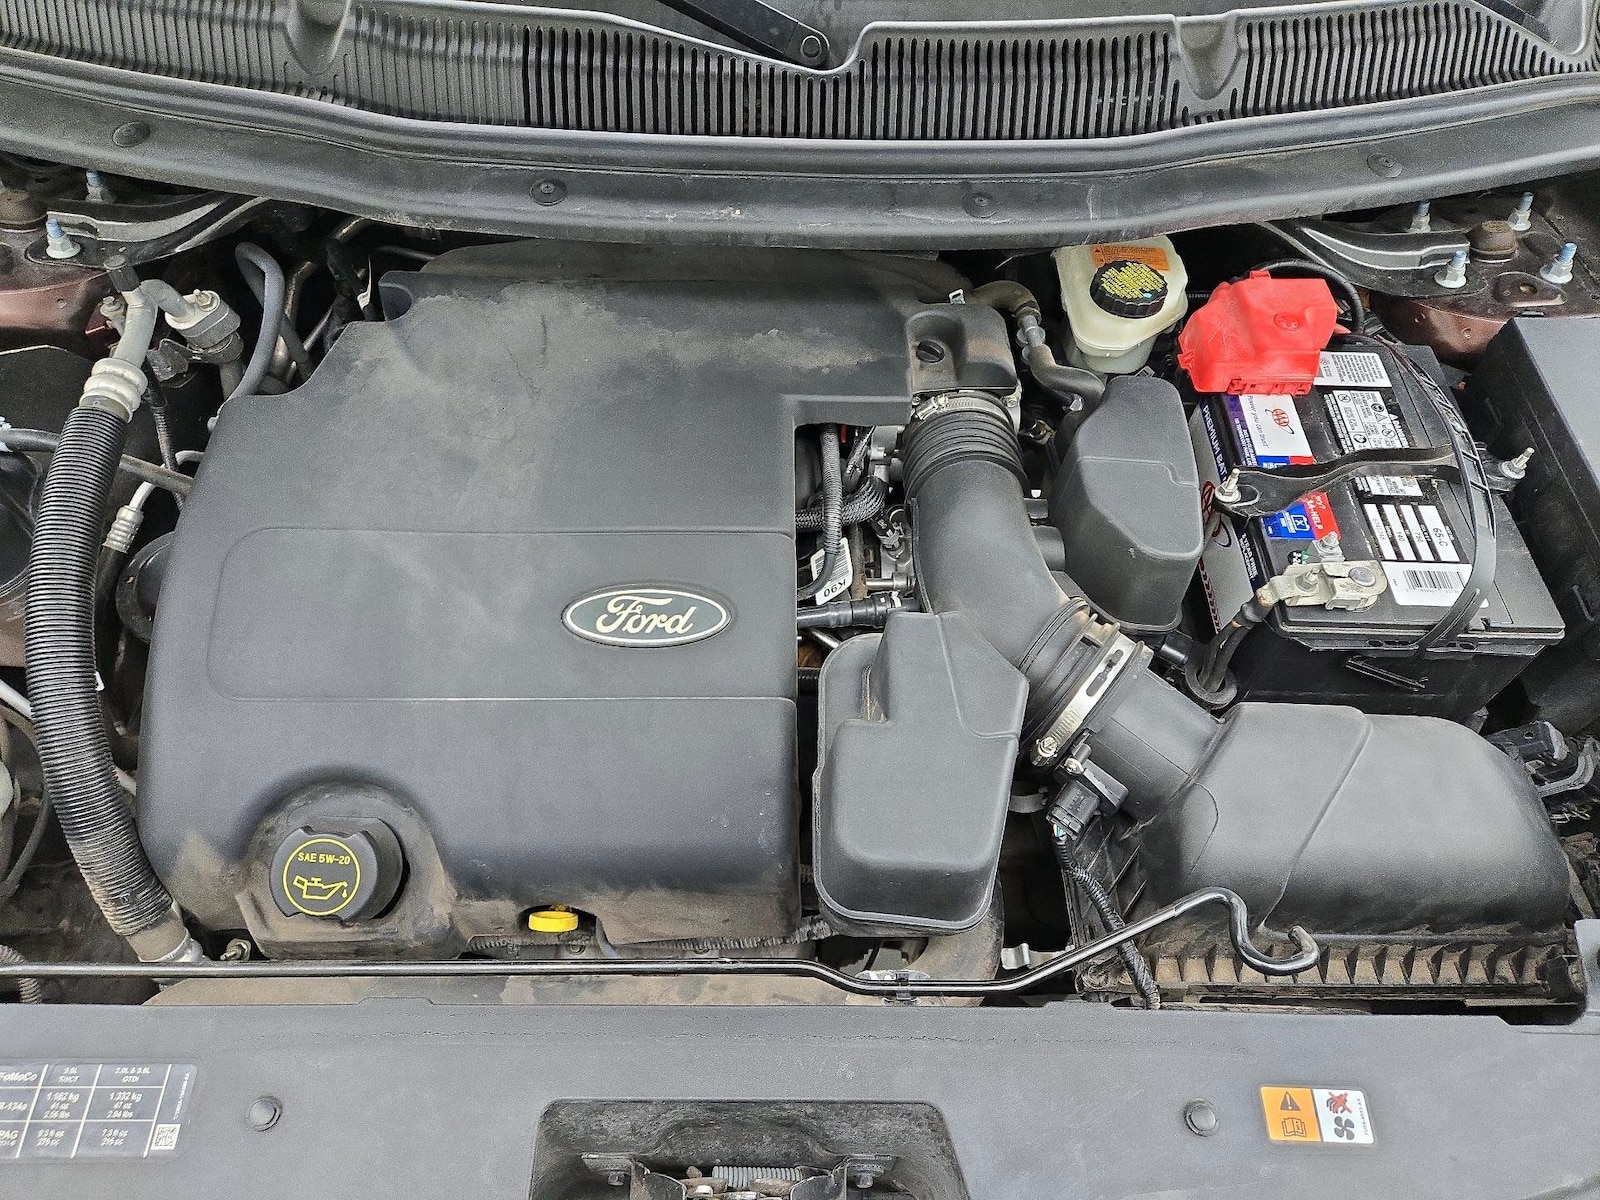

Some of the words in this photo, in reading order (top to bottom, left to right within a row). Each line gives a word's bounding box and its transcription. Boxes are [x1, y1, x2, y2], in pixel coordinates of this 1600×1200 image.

[1203, 405, 1221, 454] PREMIUM
[1432, 527, 1449, 547] 65-C
[823, 579, 846, 598] K90
[596, 595, 697, 634] Ford
[298, 853, 317, 863] SAE
[318, 854, 351, 865] 5W-20
[0, 1072, 38, 1081] FoMoCo
[68, 1091, 80, 1104] kg
[131, 1091, 143, 1103] kg
[0, 1130, 19, 1140] PAG
